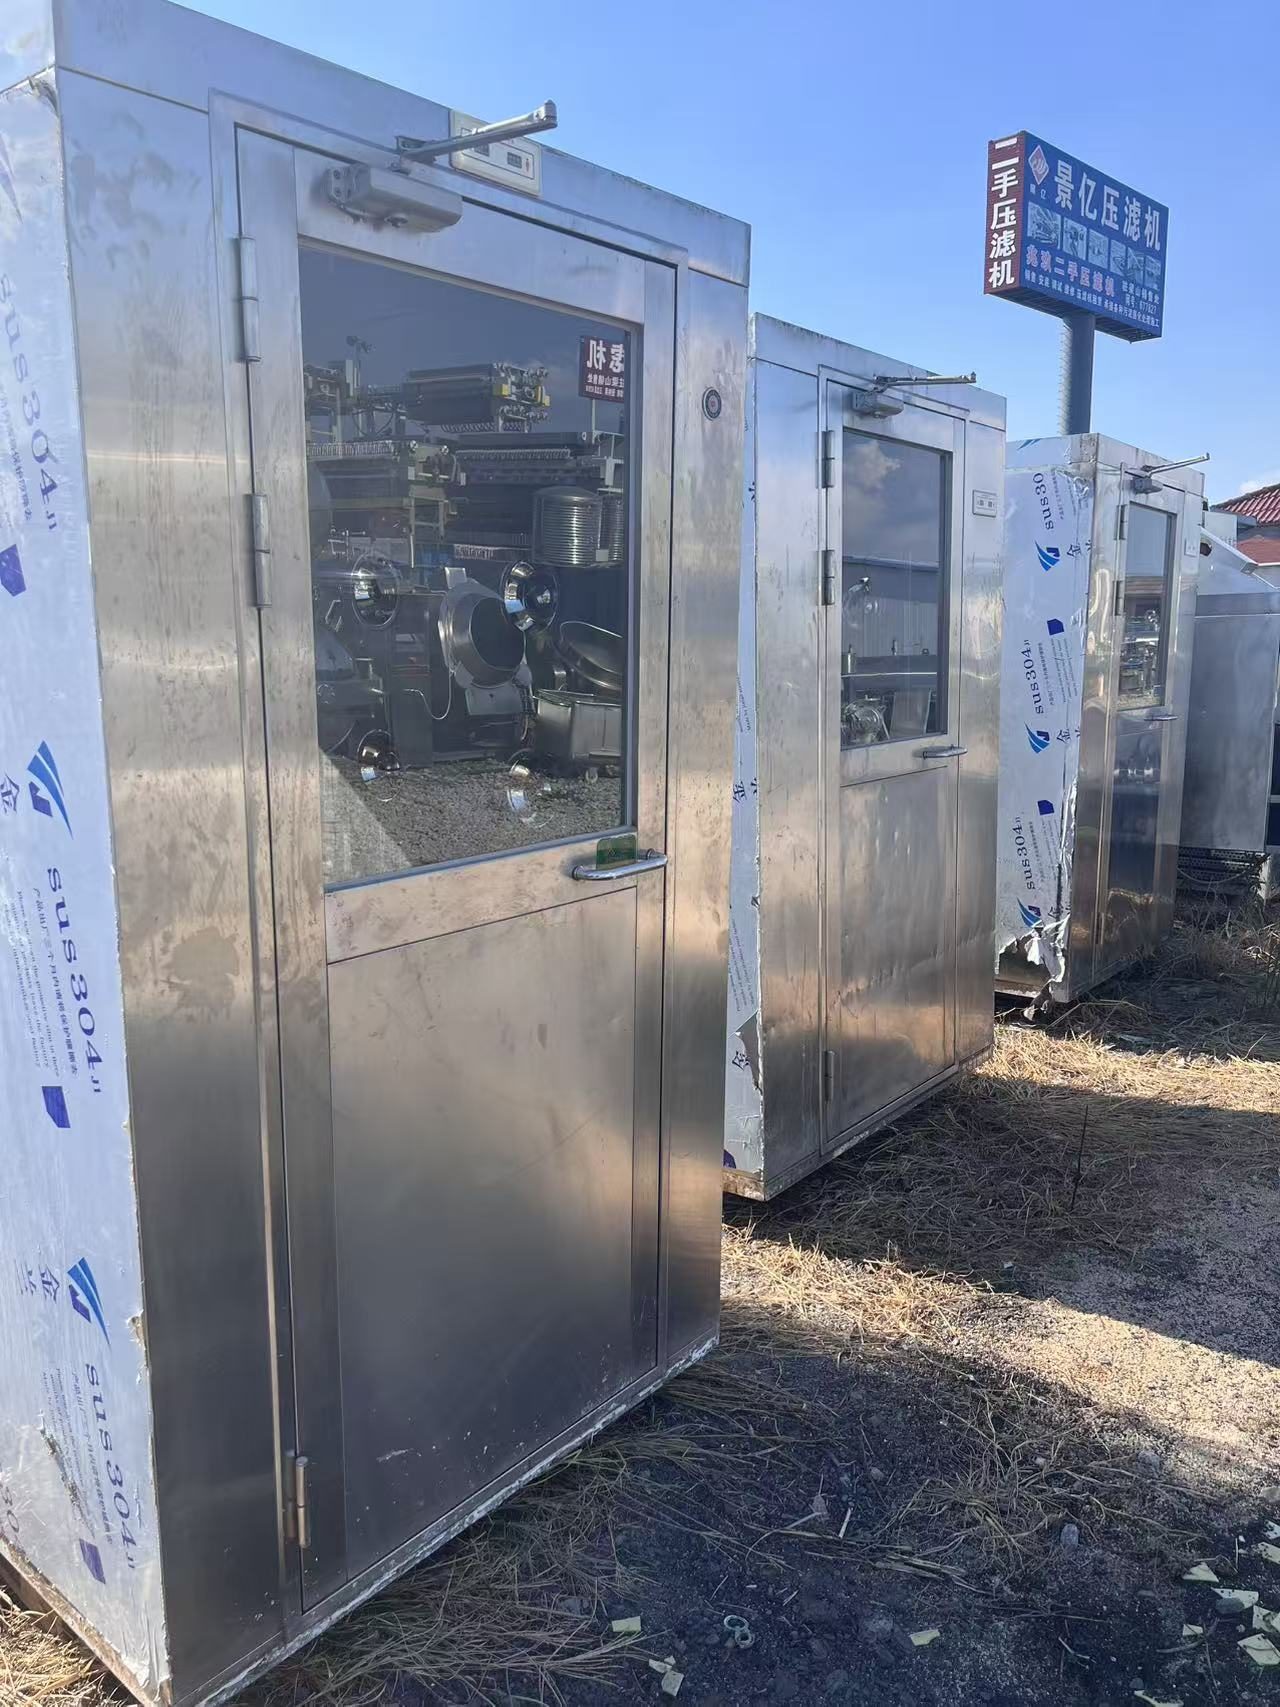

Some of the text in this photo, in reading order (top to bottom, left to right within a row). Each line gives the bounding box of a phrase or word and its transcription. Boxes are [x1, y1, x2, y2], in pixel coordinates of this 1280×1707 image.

[988, 137, 1020, 288] 二手压滤机
[1054, 160, 1161, 251] 景亿压滤机
